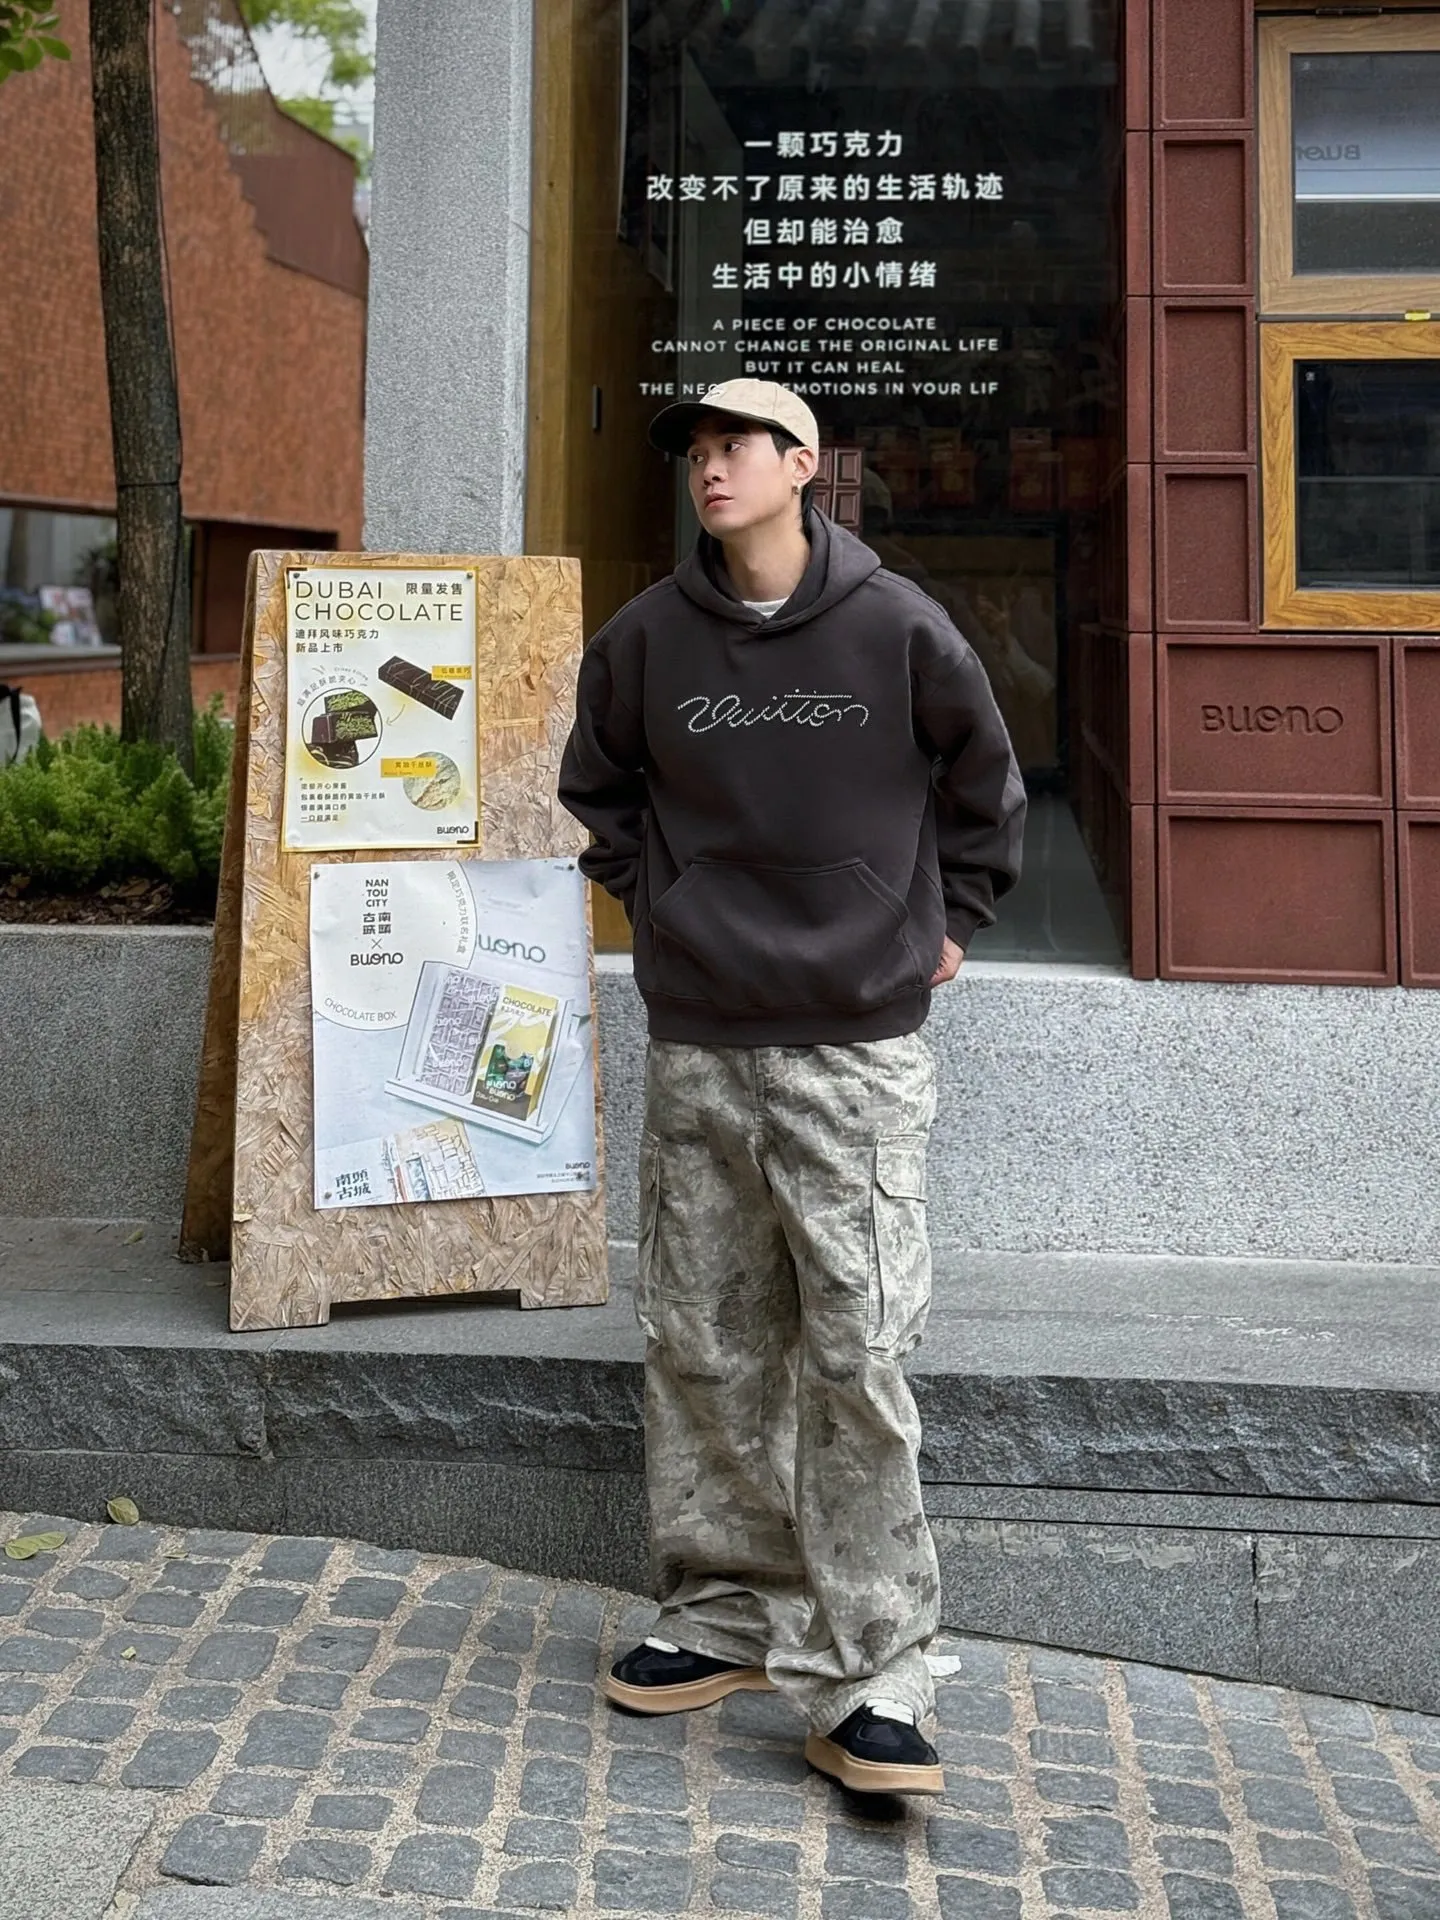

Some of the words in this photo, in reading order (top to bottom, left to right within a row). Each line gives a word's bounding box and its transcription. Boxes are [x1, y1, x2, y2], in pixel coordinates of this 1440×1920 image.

[744, 130, 902, 158] 一颗巧克力
[646, 172, 1003, 202] 改变不了原来的生活轨迹
[743, 216, 904, 246] 但却能治愈
[712, 261, 937, 290] 生活中的小情绪
[712, 319, 725, 331] A
[732, 318, 786, 331] PIECE
[793, 318, 817, 331] OF
[825, 317, 936, 331] CHOCOLATE
[651, 340, 727, 352] CANNOT
[734, 339, 810, 353] CHANGE
[818, 339, 853, 352] THE
[860, 339, 951, 352] ORIGINAL
[959, 338, 999, 352] LIFE
[745, 361, 780, 373] BUT
[788, 361, 804, 373] IT
[811, 361, 849, 374] CAN
[857, 361, 904, 373] HEAL
[639, 382, 674, 395] THE
[885, 382, 904, 395] IN
[912, 382, 962, 395] YOUR
[970, 382, 999, 395] LIF
[296, 581, 382, 599] DUBAI
[406, 582, 463, 596] 限量发售
[294, 602, 463, 621] CHOCOLATE
[296, 642, 343, 654] 新品上市
[365, 879, 389, 887] NAN
[367, 888, 388, 897] TOU
[366, 898, 388, 908] CITY
[325, 997, 375, 1021] CHOCOLATE
[378, 1009, 397, 1021] BOX
[502, 996, 553, 1017] CHOCOLATE
